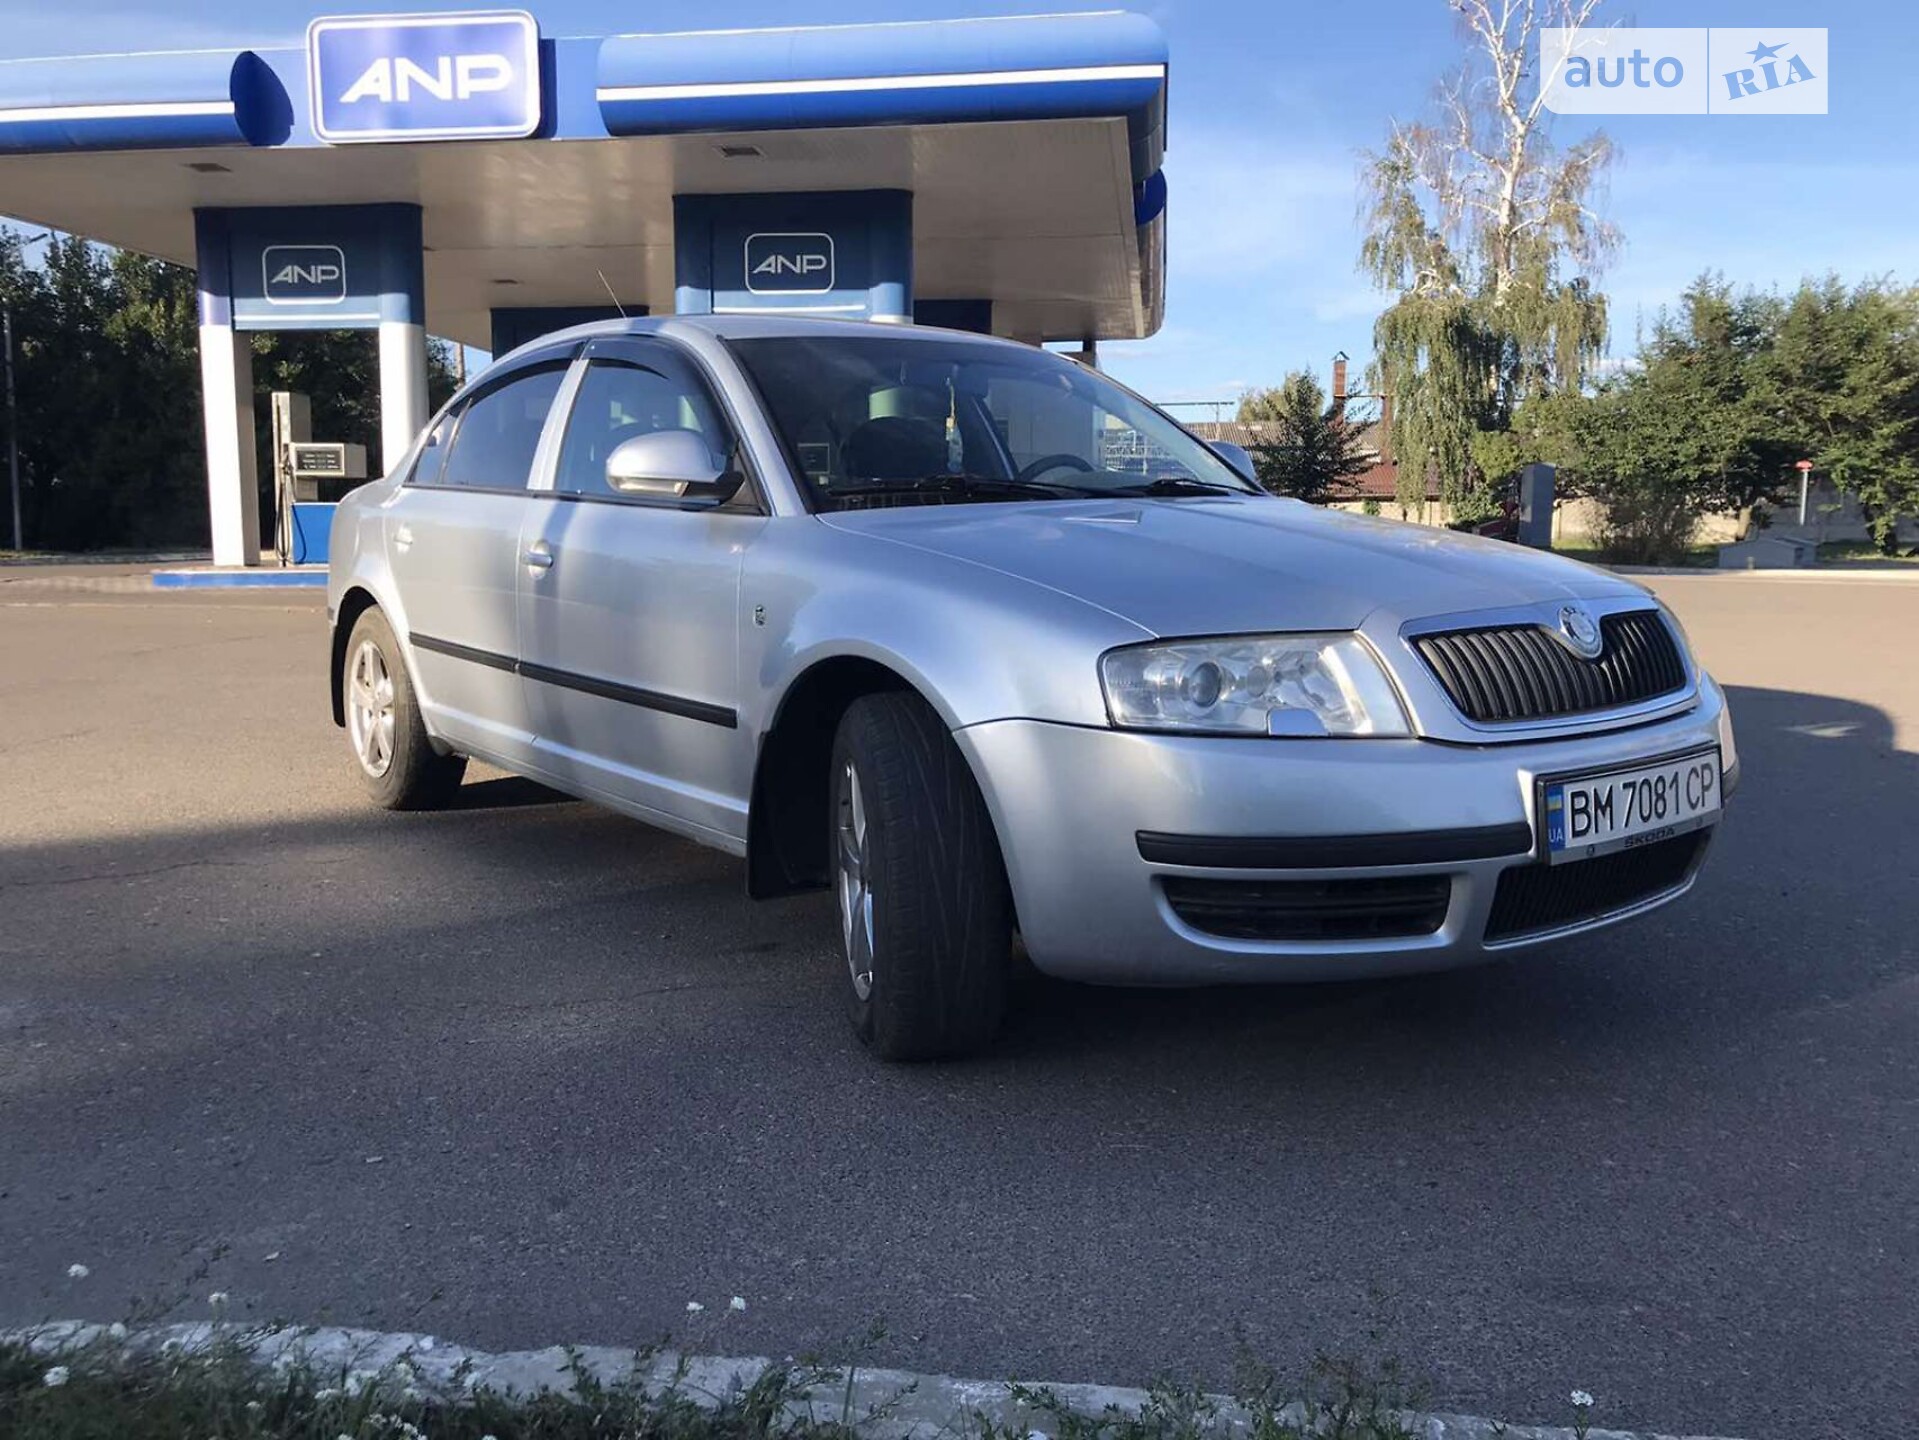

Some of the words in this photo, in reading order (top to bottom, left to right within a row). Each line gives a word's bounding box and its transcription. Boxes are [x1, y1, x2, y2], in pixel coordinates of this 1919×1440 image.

[341, 53, 513, 103] ANP
[269, 264, 340, 285] ANP
[752, 254, 827, 275] ANP
[1569, 785, 1614, 839] BM
[1622, 774, 1680, 828] 7081
[1686, 762, 1714, 811] CP
[1549, 830, 1565, 843] UA
